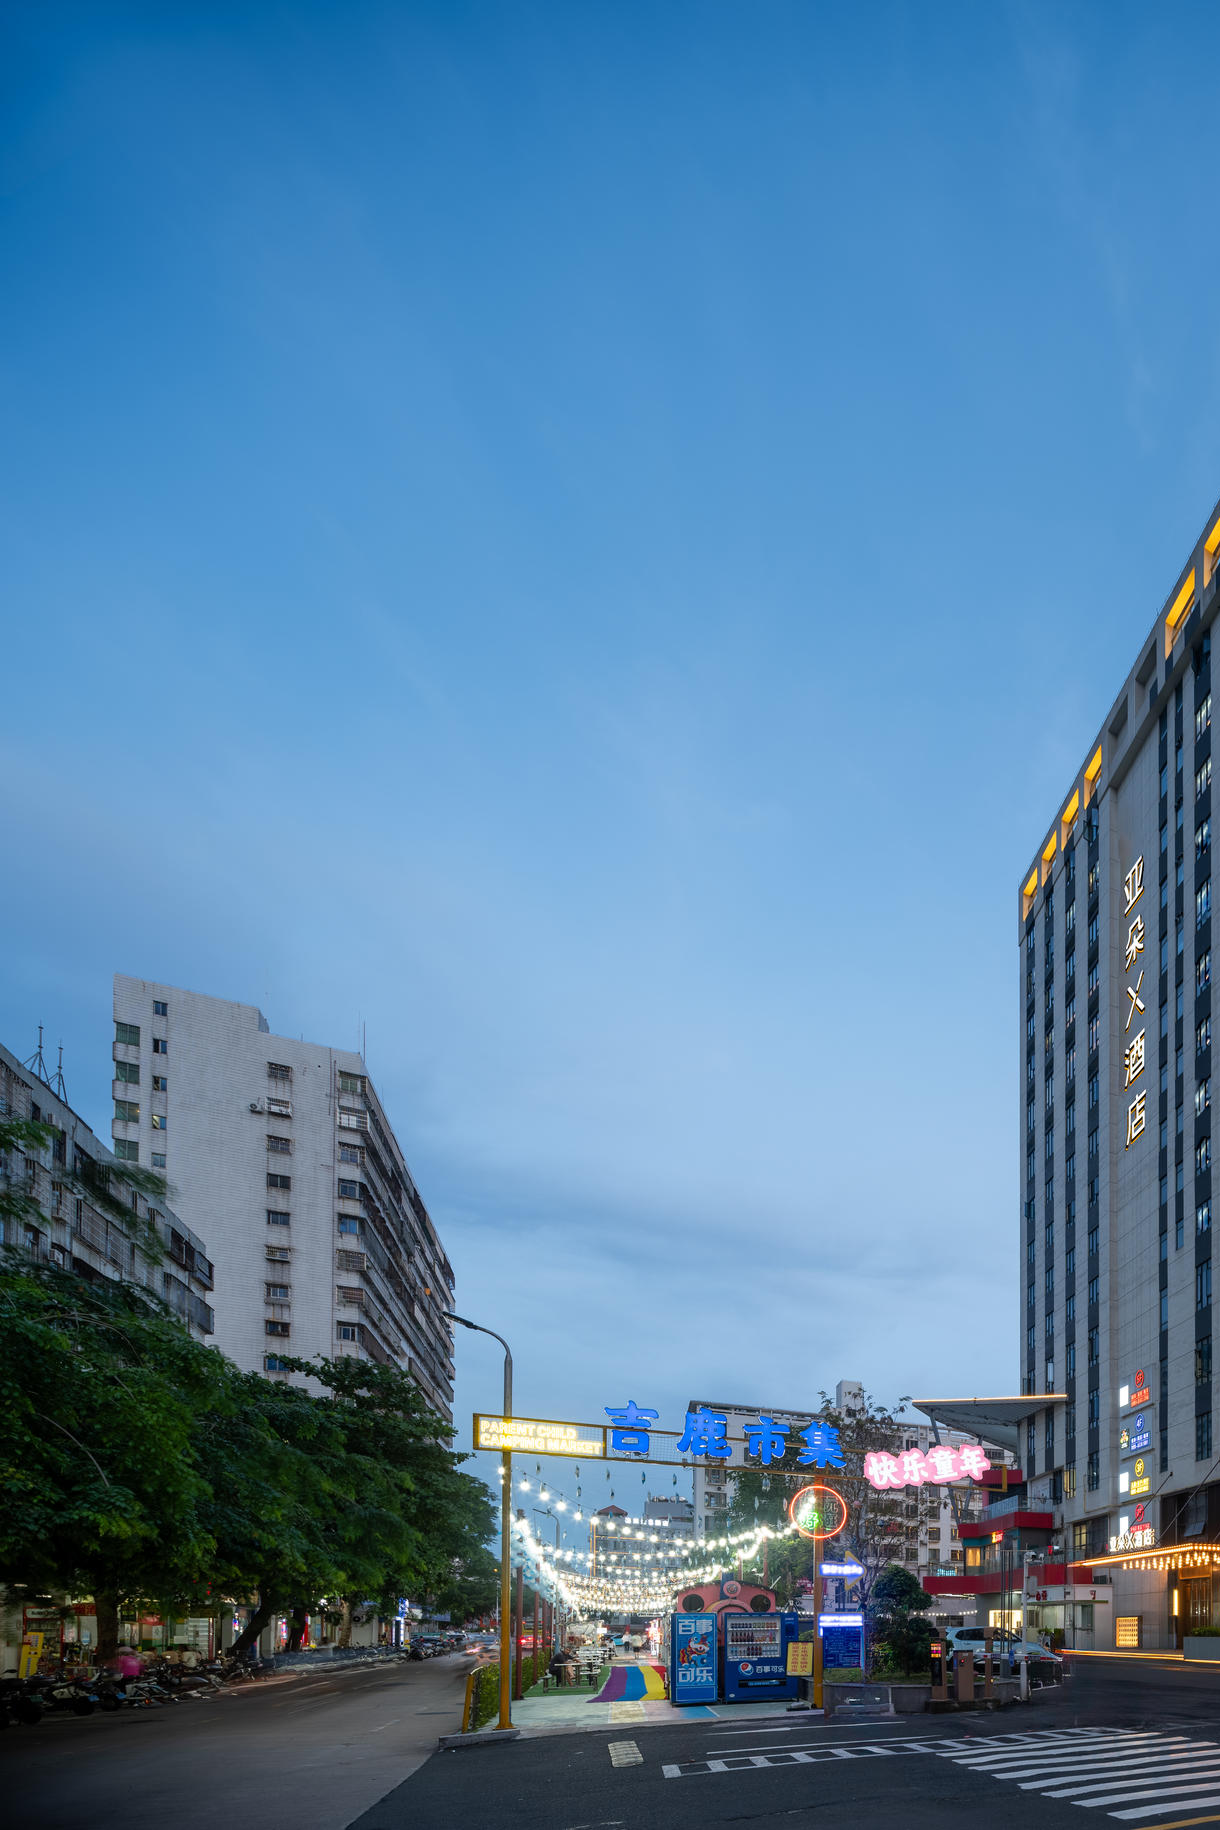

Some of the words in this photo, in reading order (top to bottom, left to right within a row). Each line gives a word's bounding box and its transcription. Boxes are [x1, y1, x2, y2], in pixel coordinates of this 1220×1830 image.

[1124, 855, 1147, 1150] 亚朵X酒店
[480, 1420, 536, 1435] PARENT
[536, 1425, 577, 1440] CHILD
[604, 1400, 847, 1468] 吉鹿市集
[480, 1433, 545, 1450] CAMPING
[546, 1438, 602, 1455] MARKET
[868, 1448, 987, 1484] 快乐童年
[678, 1619, 713, 1634] 百事
[678, 1666, 713, 1682] 可乐
[755, 1665, 785, 1673] 百事可乐
